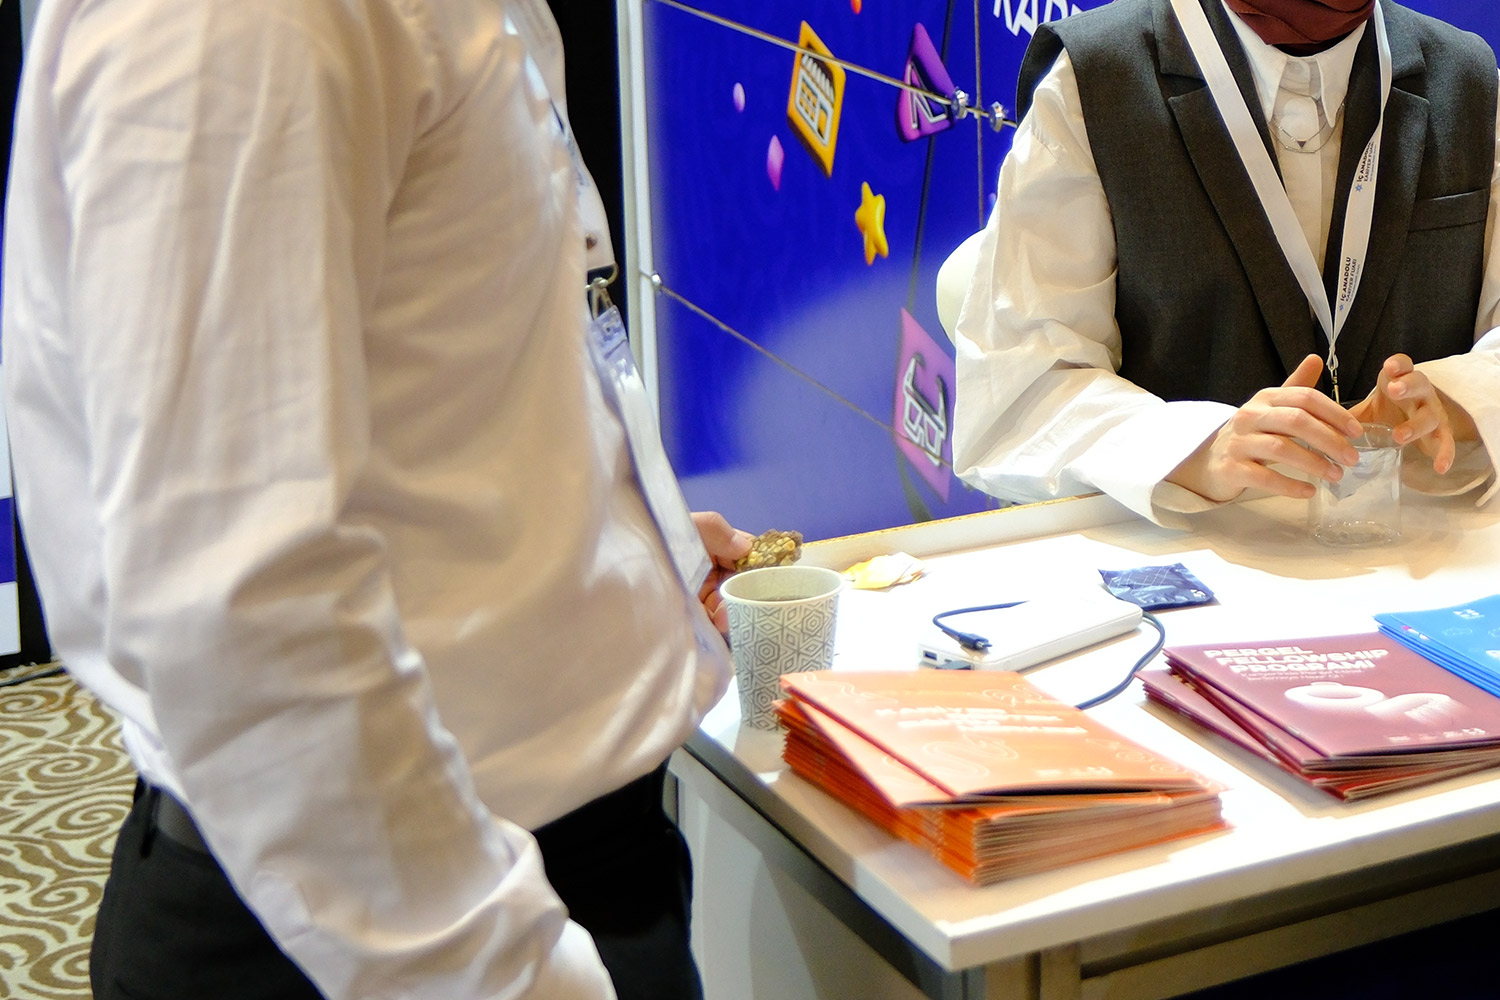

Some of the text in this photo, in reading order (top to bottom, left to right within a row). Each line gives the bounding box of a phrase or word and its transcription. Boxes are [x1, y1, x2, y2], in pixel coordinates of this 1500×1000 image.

[1342, 256, 1351, 291] ANADOLU
[1203, 646, 1314, 659] PERGEL
[1216, 649, 1389, 666] FELLOWSHIP
[1229, 659, 1376, 674] PROGRAMI
